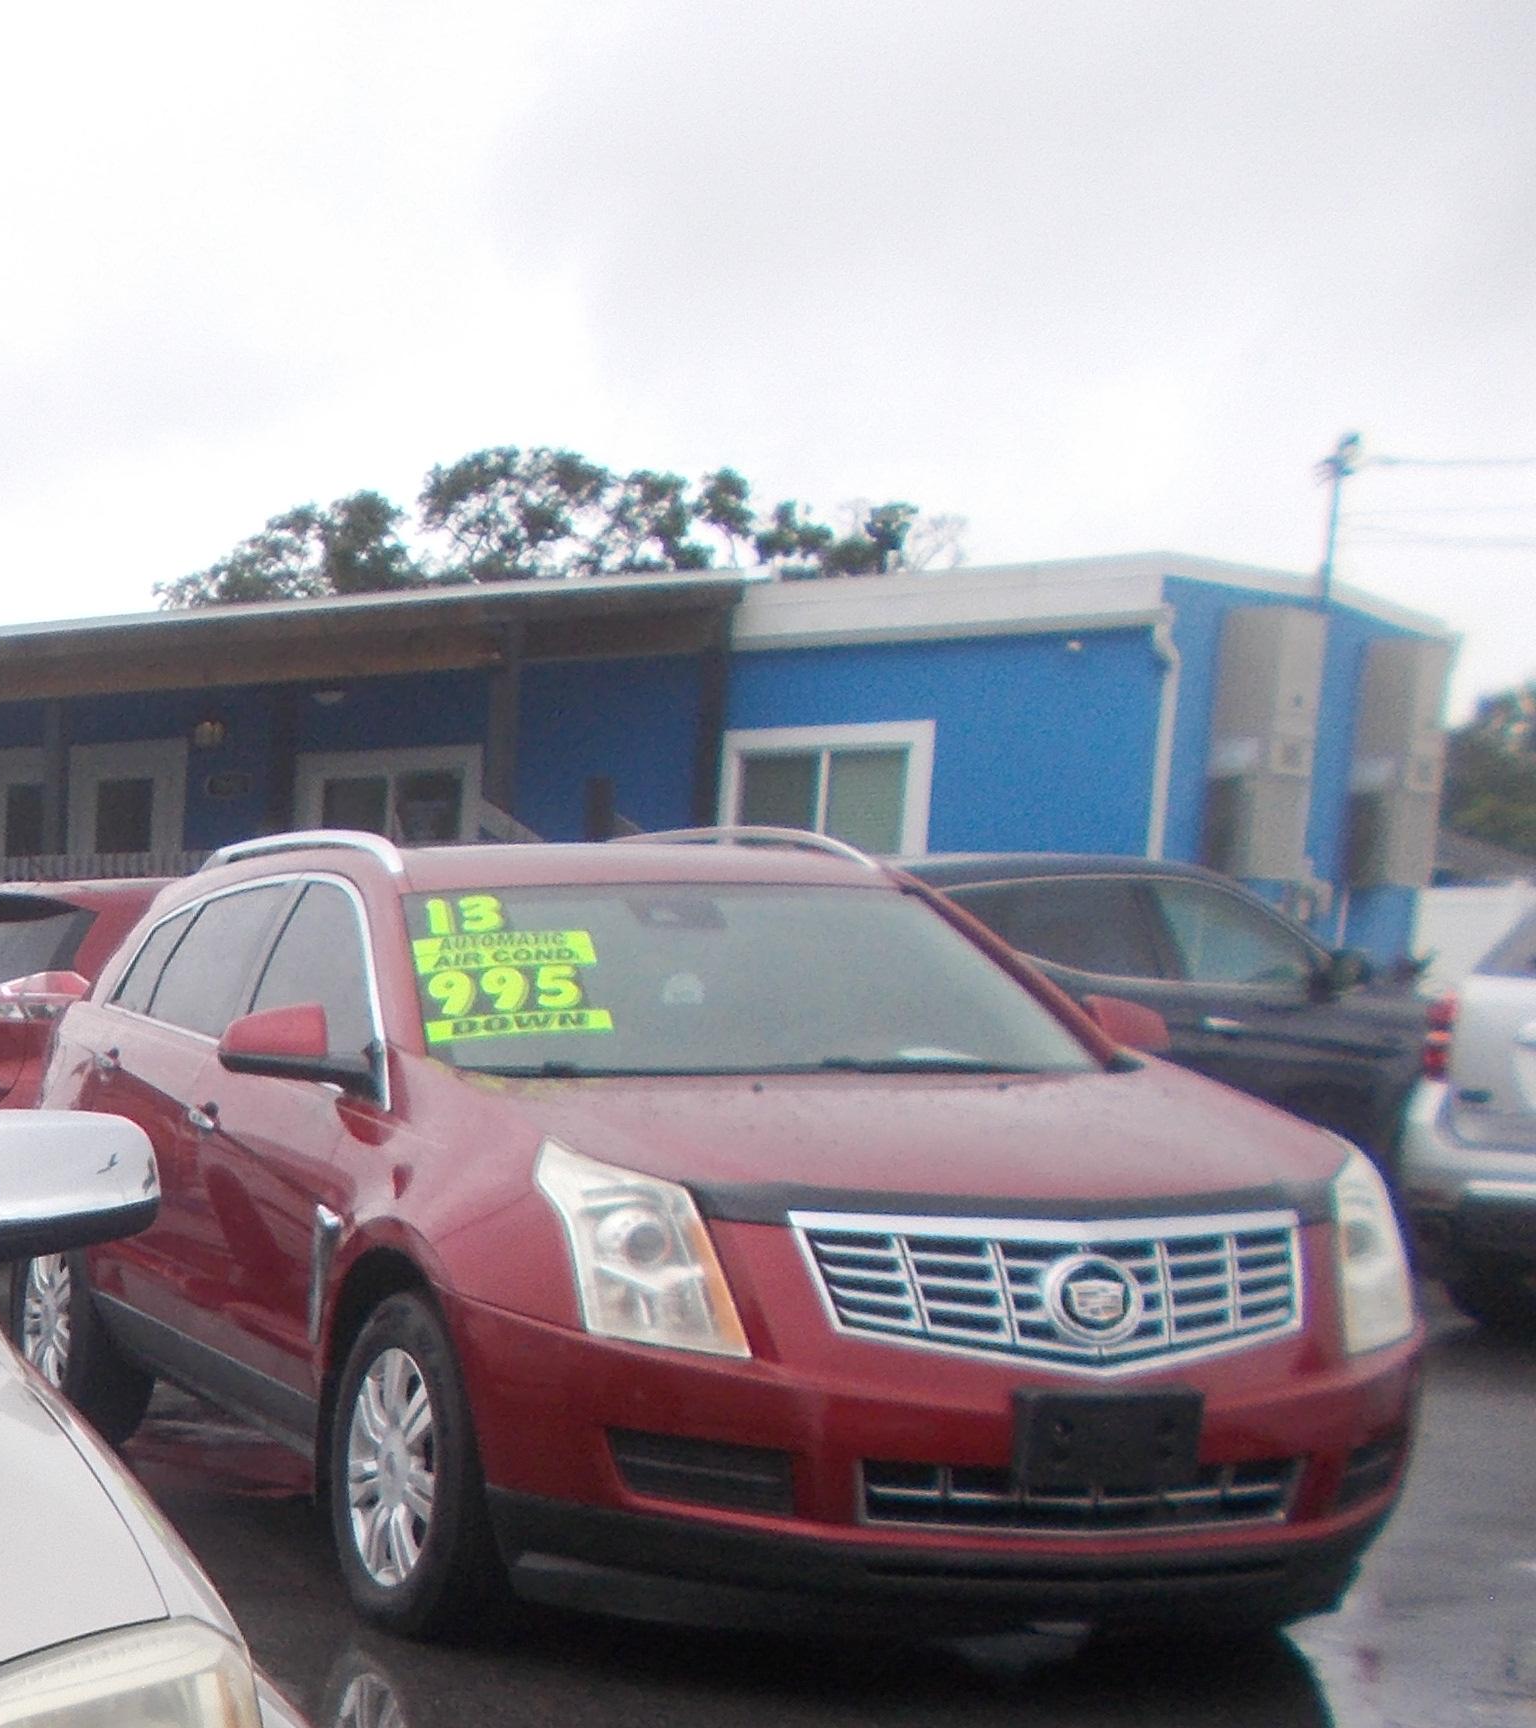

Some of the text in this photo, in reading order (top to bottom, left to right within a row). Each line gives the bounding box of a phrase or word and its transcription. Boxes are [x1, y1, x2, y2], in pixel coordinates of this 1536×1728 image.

[426, 894, 503, 935] 13
[439, 932, 566, 951] AUTOMATIC
[433, 953, 479, 970] AIR
[428, 964, 583, 1017] 995
[451, 1010, 589, 1036] DOWN
